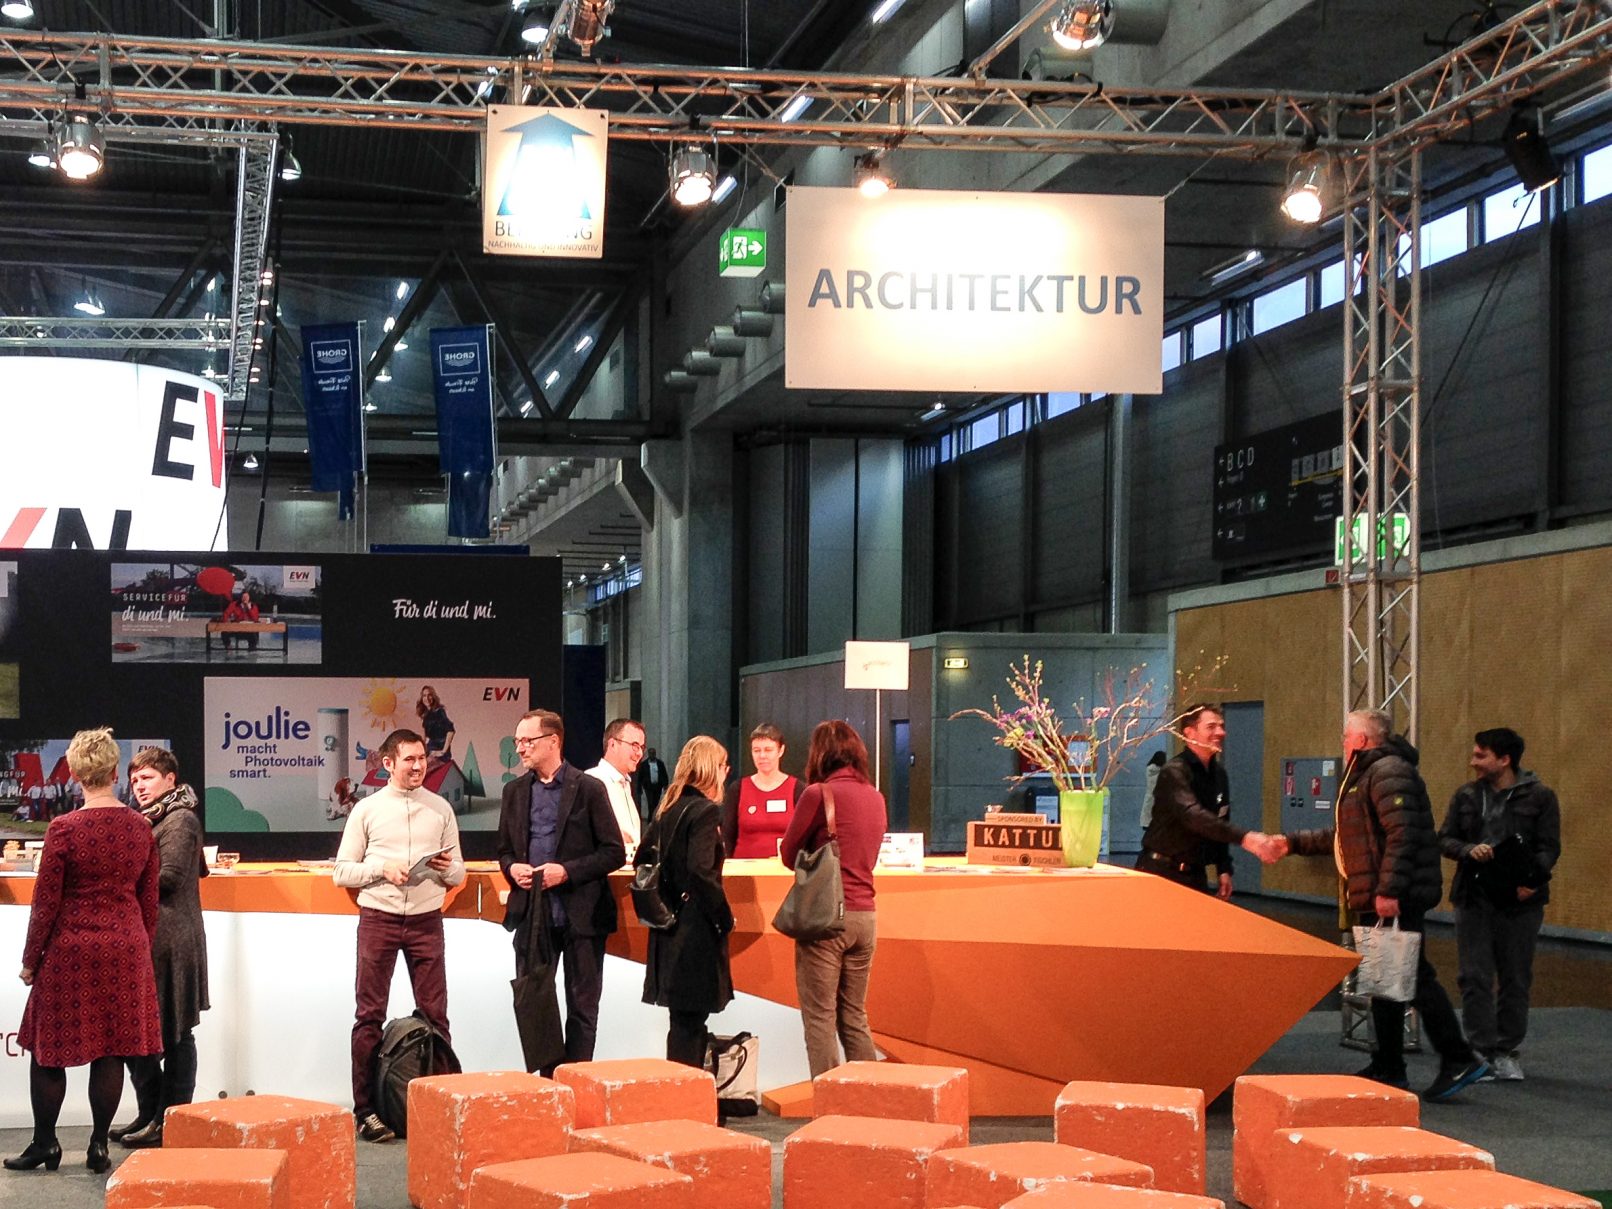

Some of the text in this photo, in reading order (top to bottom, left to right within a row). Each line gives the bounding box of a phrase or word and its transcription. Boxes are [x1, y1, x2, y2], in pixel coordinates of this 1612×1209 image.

[807, 268, 1142, 315] ARCHITEKTUR
[289, 571, 310, 580] EVN
[122, 605, 136, 621] di
[138, 605, 164, 622] und
[392, 598, 497, 621] Für di und mi.
[483, 687, 520, 701] EVN
[222, 705, 311, 750] joulie
[237, 743, 278, 754] macht
[245, 755, 325, 768] Photovoltaik
[229, 768, 271, 779] smart.
[983, 827, 1062, 848] KATTU
